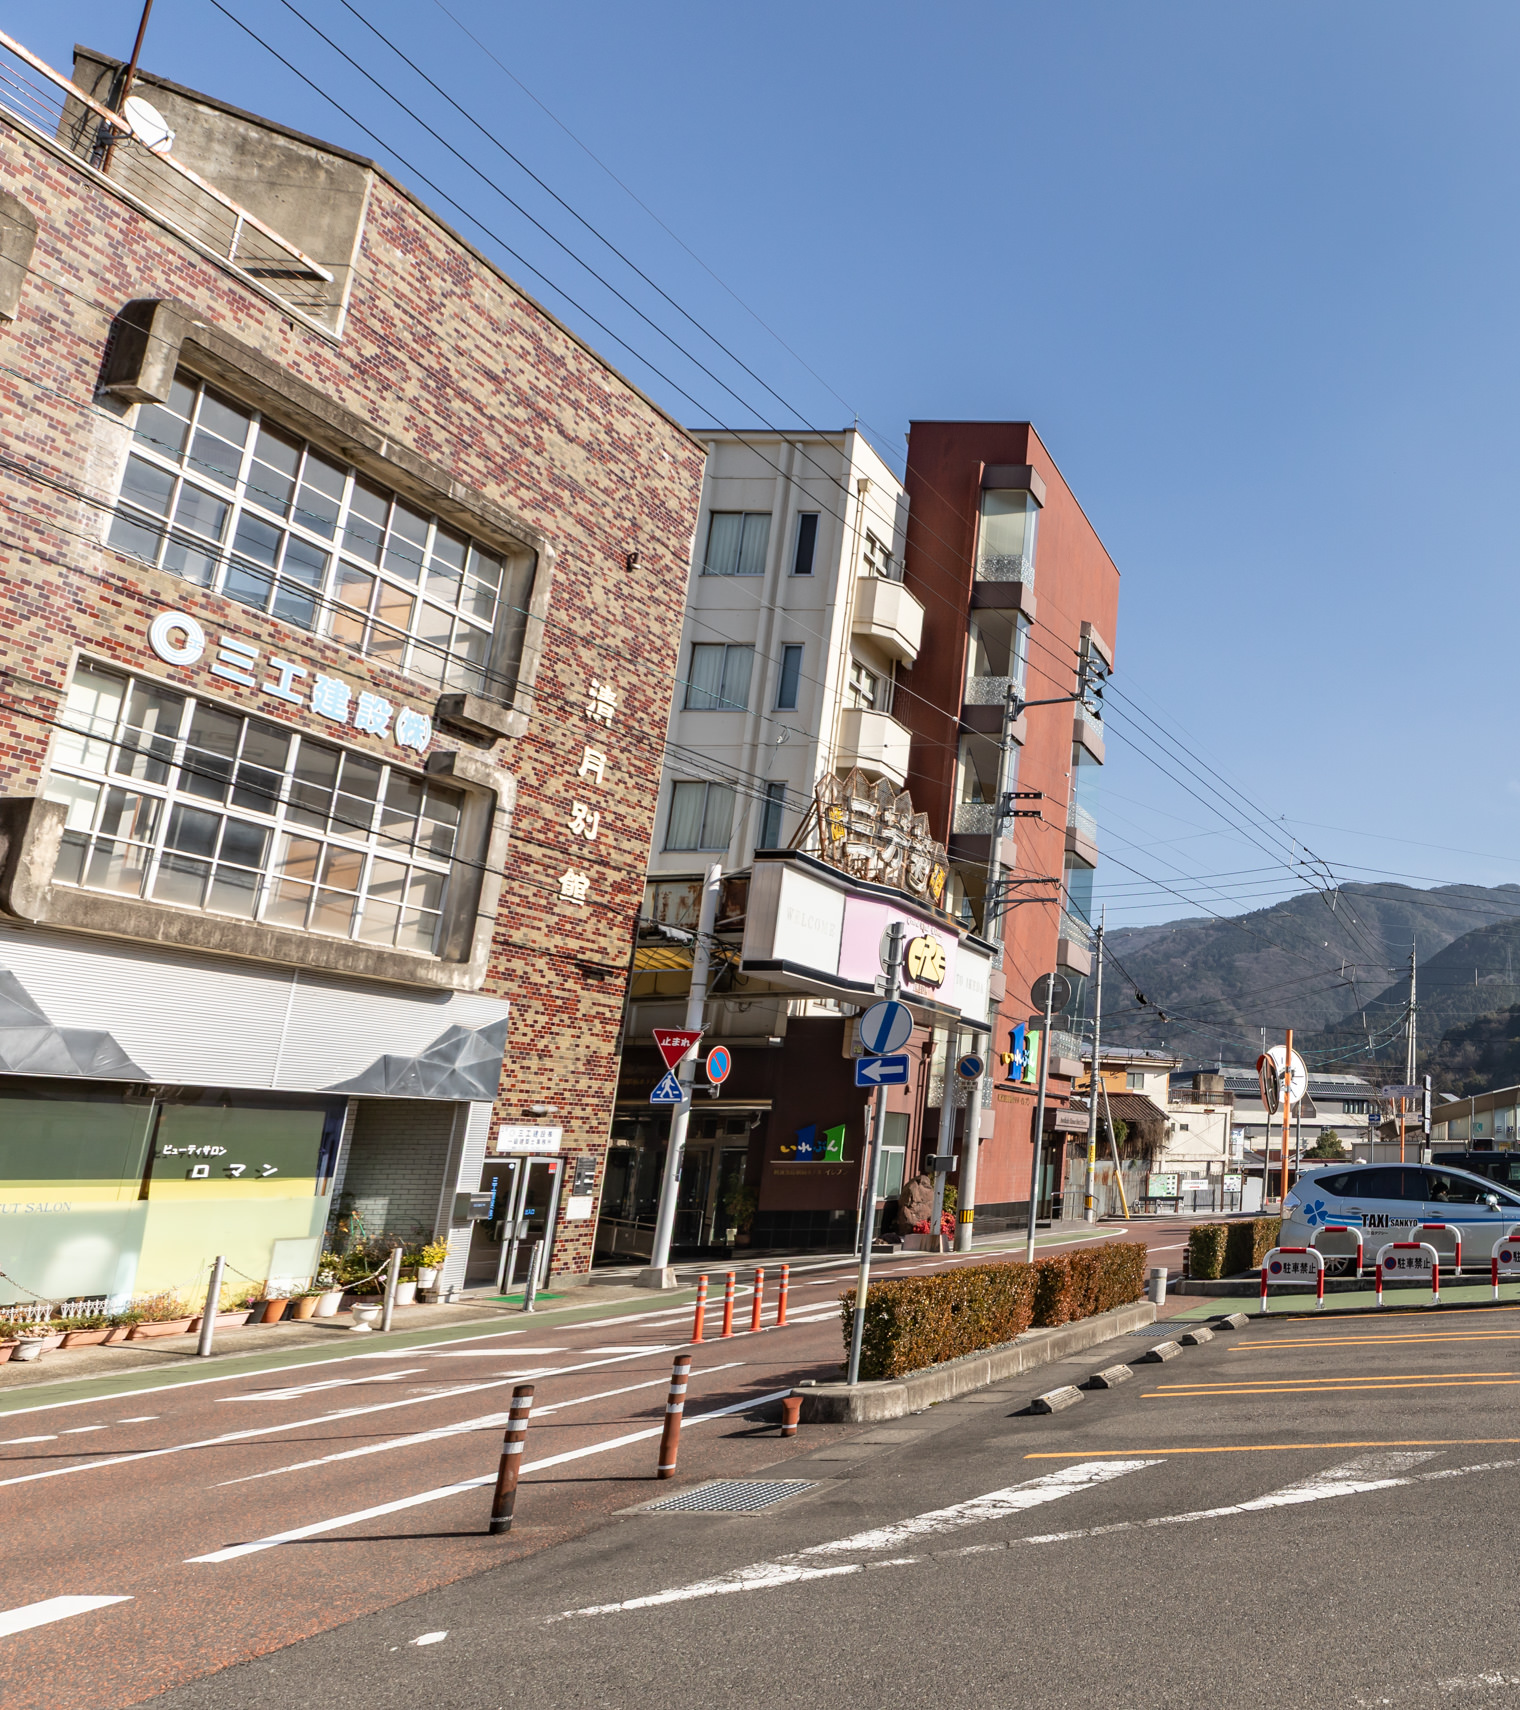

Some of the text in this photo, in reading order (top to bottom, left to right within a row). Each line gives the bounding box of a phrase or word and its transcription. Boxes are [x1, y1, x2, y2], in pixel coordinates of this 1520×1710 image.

[209, 635, 432, 753] 三工建設(株)
[557, 677, 618, 906] 清月別館
[660, 1037, 691, 1047] 止まれ
[163, 1144, 227, 1156] ビューティサロン
[191, 1163, 278, 1178] ロマン
[24, 1201, 72, 1214] SALON
[1361, 1213, 1418, 1228] TAXI SANKYO
[1283, 1262, 1316, 1274] 駐車禁止
[1397, 1257, 1431, 1269] 駐車禁止
